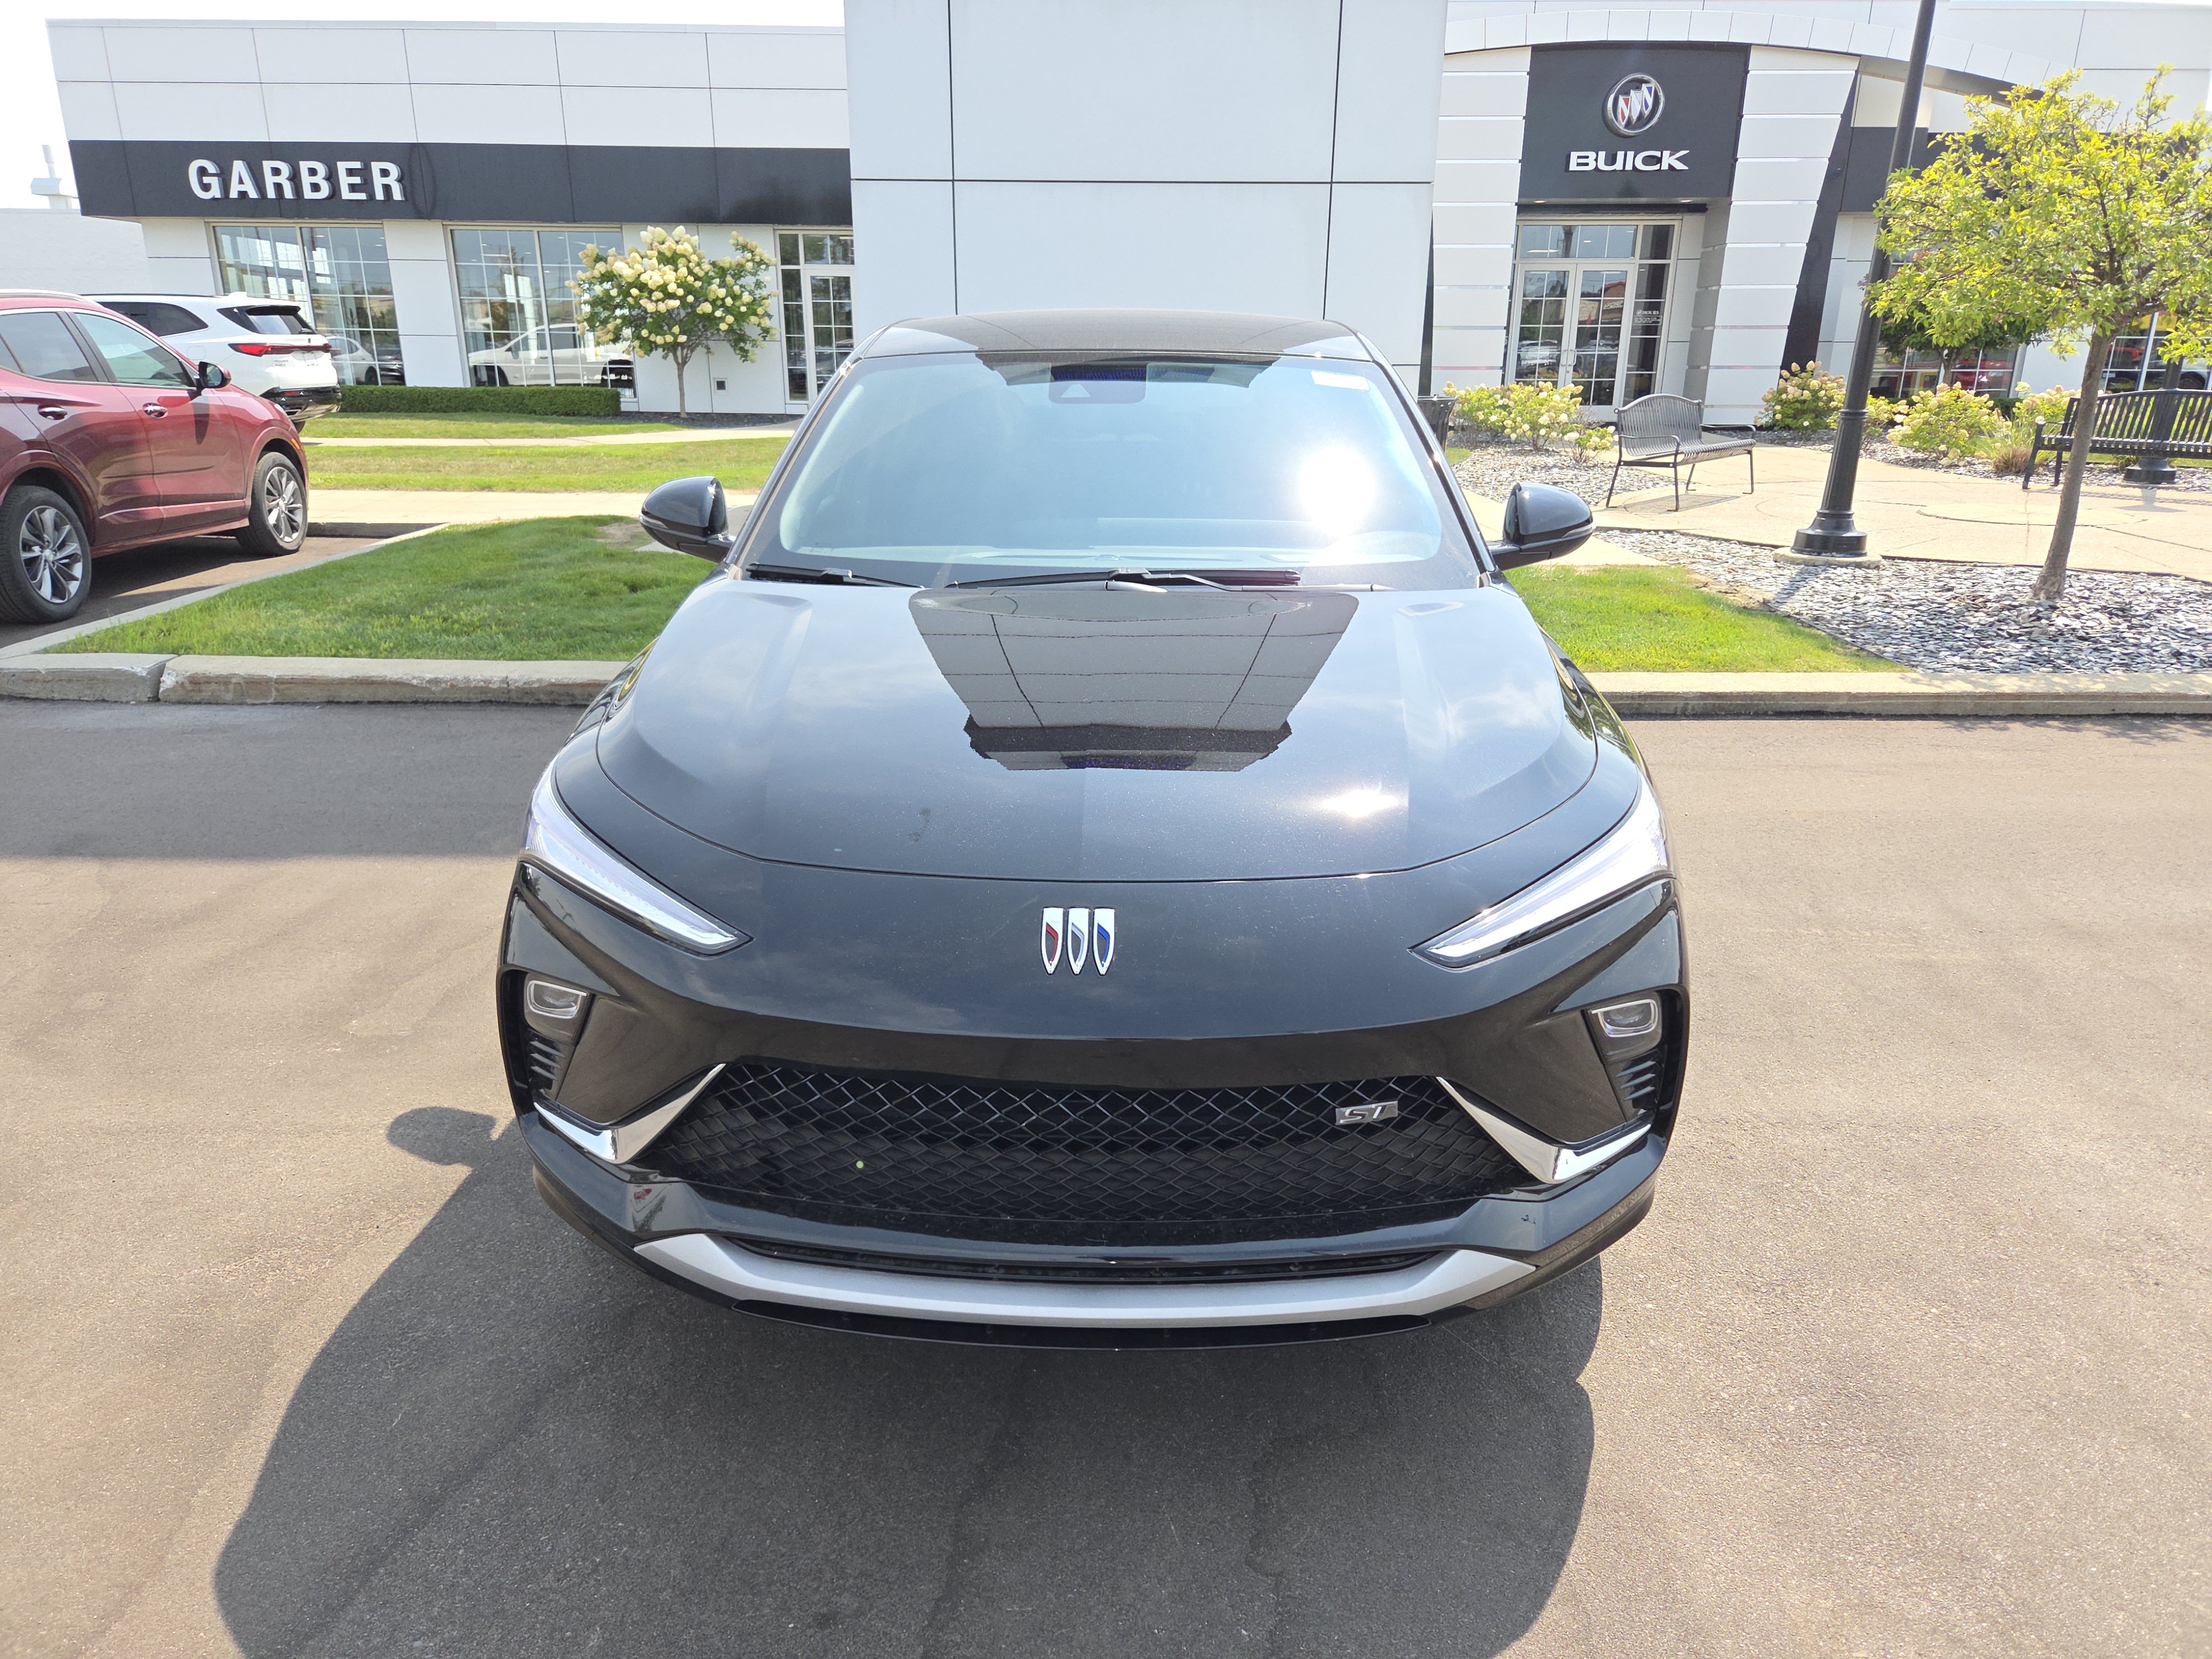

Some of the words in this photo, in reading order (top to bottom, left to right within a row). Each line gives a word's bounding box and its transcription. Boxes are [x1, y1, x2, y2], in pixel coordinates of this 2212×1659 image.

[1569, 150, 1690, 171] BUICK
[188, 159, 405, 201] GARBER
[1337, 1100, 1397, 1124] ST
